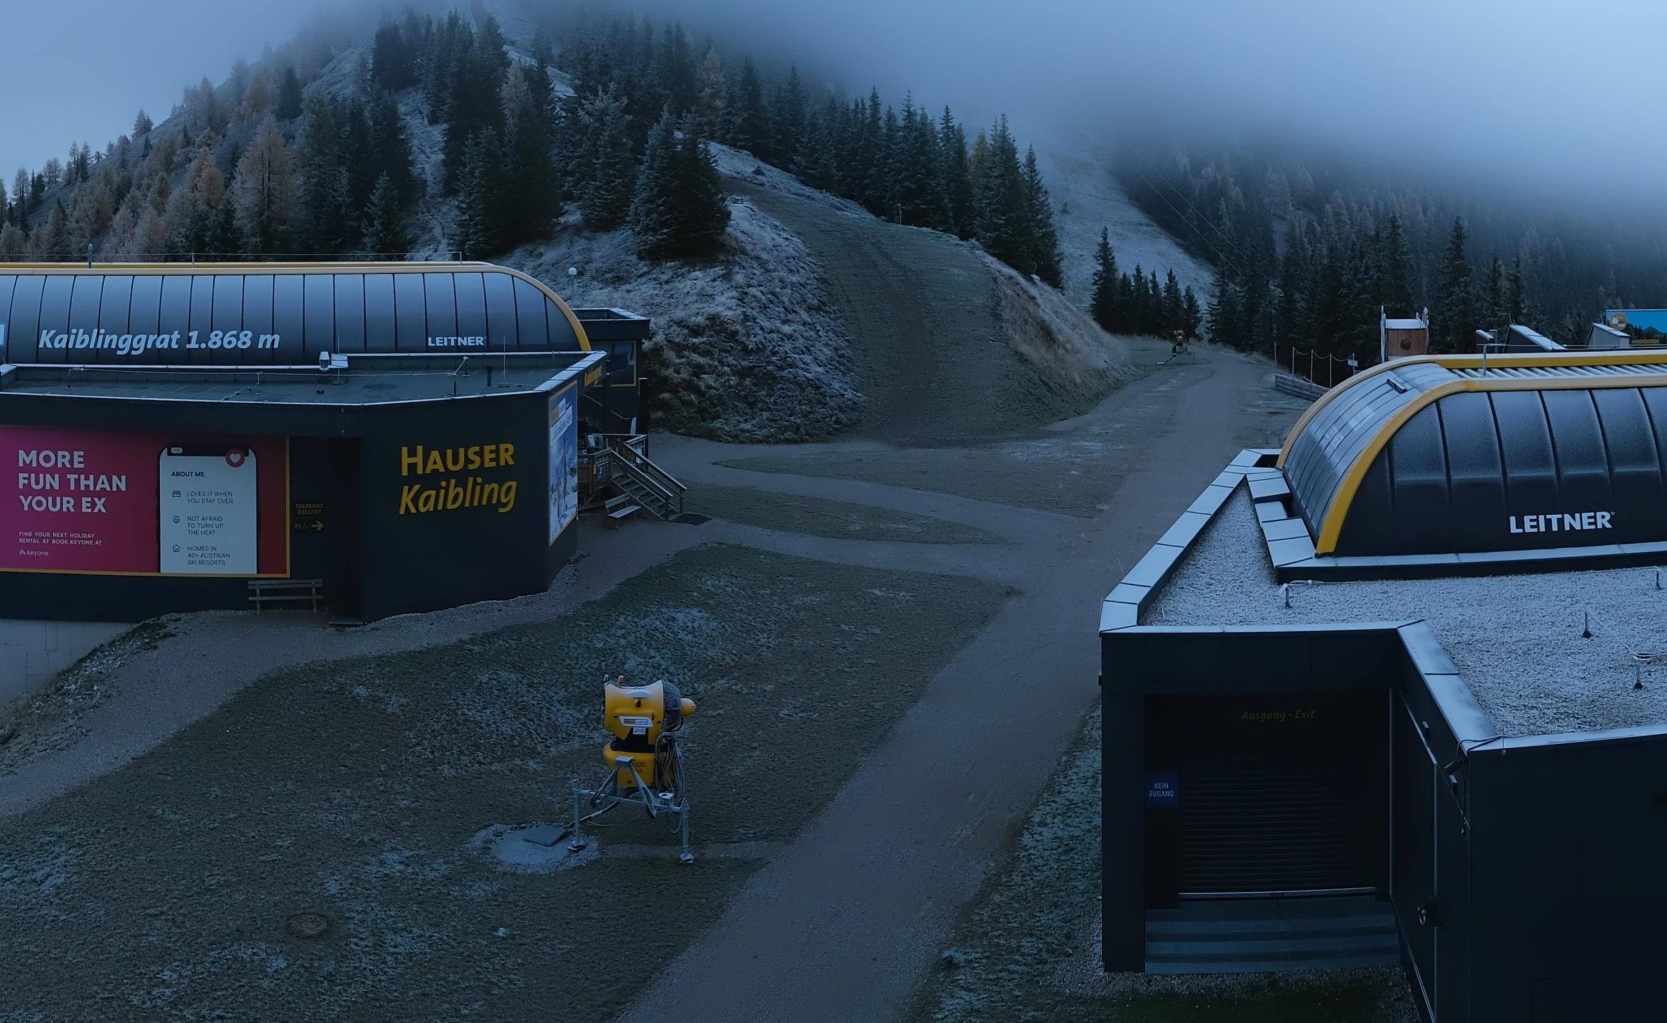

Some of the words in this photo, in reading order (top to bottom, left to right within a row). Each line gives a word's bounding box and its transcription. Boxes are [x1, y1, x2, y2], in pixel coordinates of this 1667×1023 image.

[38, 329, 181, 355] Kaiblinggrat
[185, 330, 252, 349] 1.868
[258, 333, 280, 349] m
[427, 336, 485, 347] LEITNER
[18, 449, 85, 469] MORE
[400, 443, 516, 477] HAUSER
[18, 473, 60, 490] FUN
[66, 474, 127, 491] THAN
[19, 495, 75, 512] YOUR
[81, 497, 107, 513] EX
[398, 476, 518, 515] Kaibling
[1509, 511, 1613, 533] LEITNER
[1241, 710, 1286, 722] Ausgang
[1295, 709, 1315, 719] Exit
